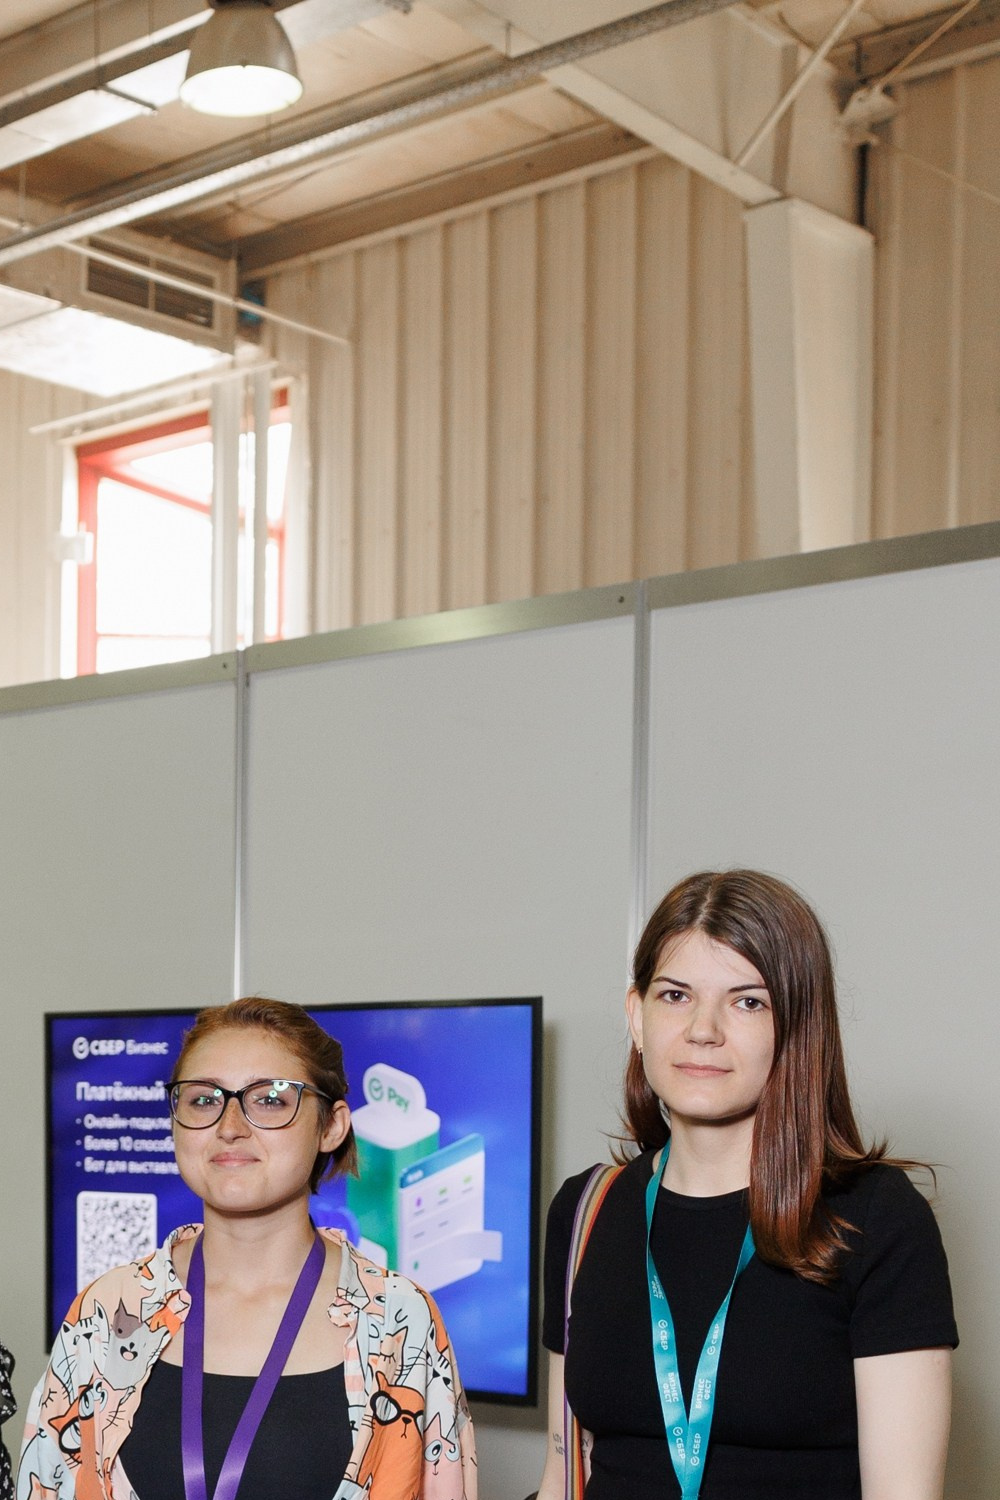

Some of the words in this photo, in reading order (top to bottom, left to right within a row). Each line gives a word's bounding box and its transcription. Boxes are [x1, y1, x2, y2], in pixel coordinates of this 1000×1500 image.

[90, 1040, 125, 1055] СБЕР
[126, 1040, 169, 1055] Бизнес
[76, 1081, 165, 1101] Платёжный
[387, 1088, 410, 1113] Pay
[84, 1135, 118, 1151] Более
[120, 1136, 132, 1151] 10
[105, 1161, 127, 1174] для
[660, 1330, 668, 1350] СБЕР
[711, 1323, 720, 1345] СБЕР
[662, 1383, 672, 1403] ФЕСТ
[668, 1372, 679, 1403] БИЗНЕС
[695, 1378, 706, 1409] БИЗНЕС
[704, 1379, 712, 1401] ФЕСТ
[676, 1437, 686, 1460] СБЕР
[692, 1433, 702, 1454] СБЕР
